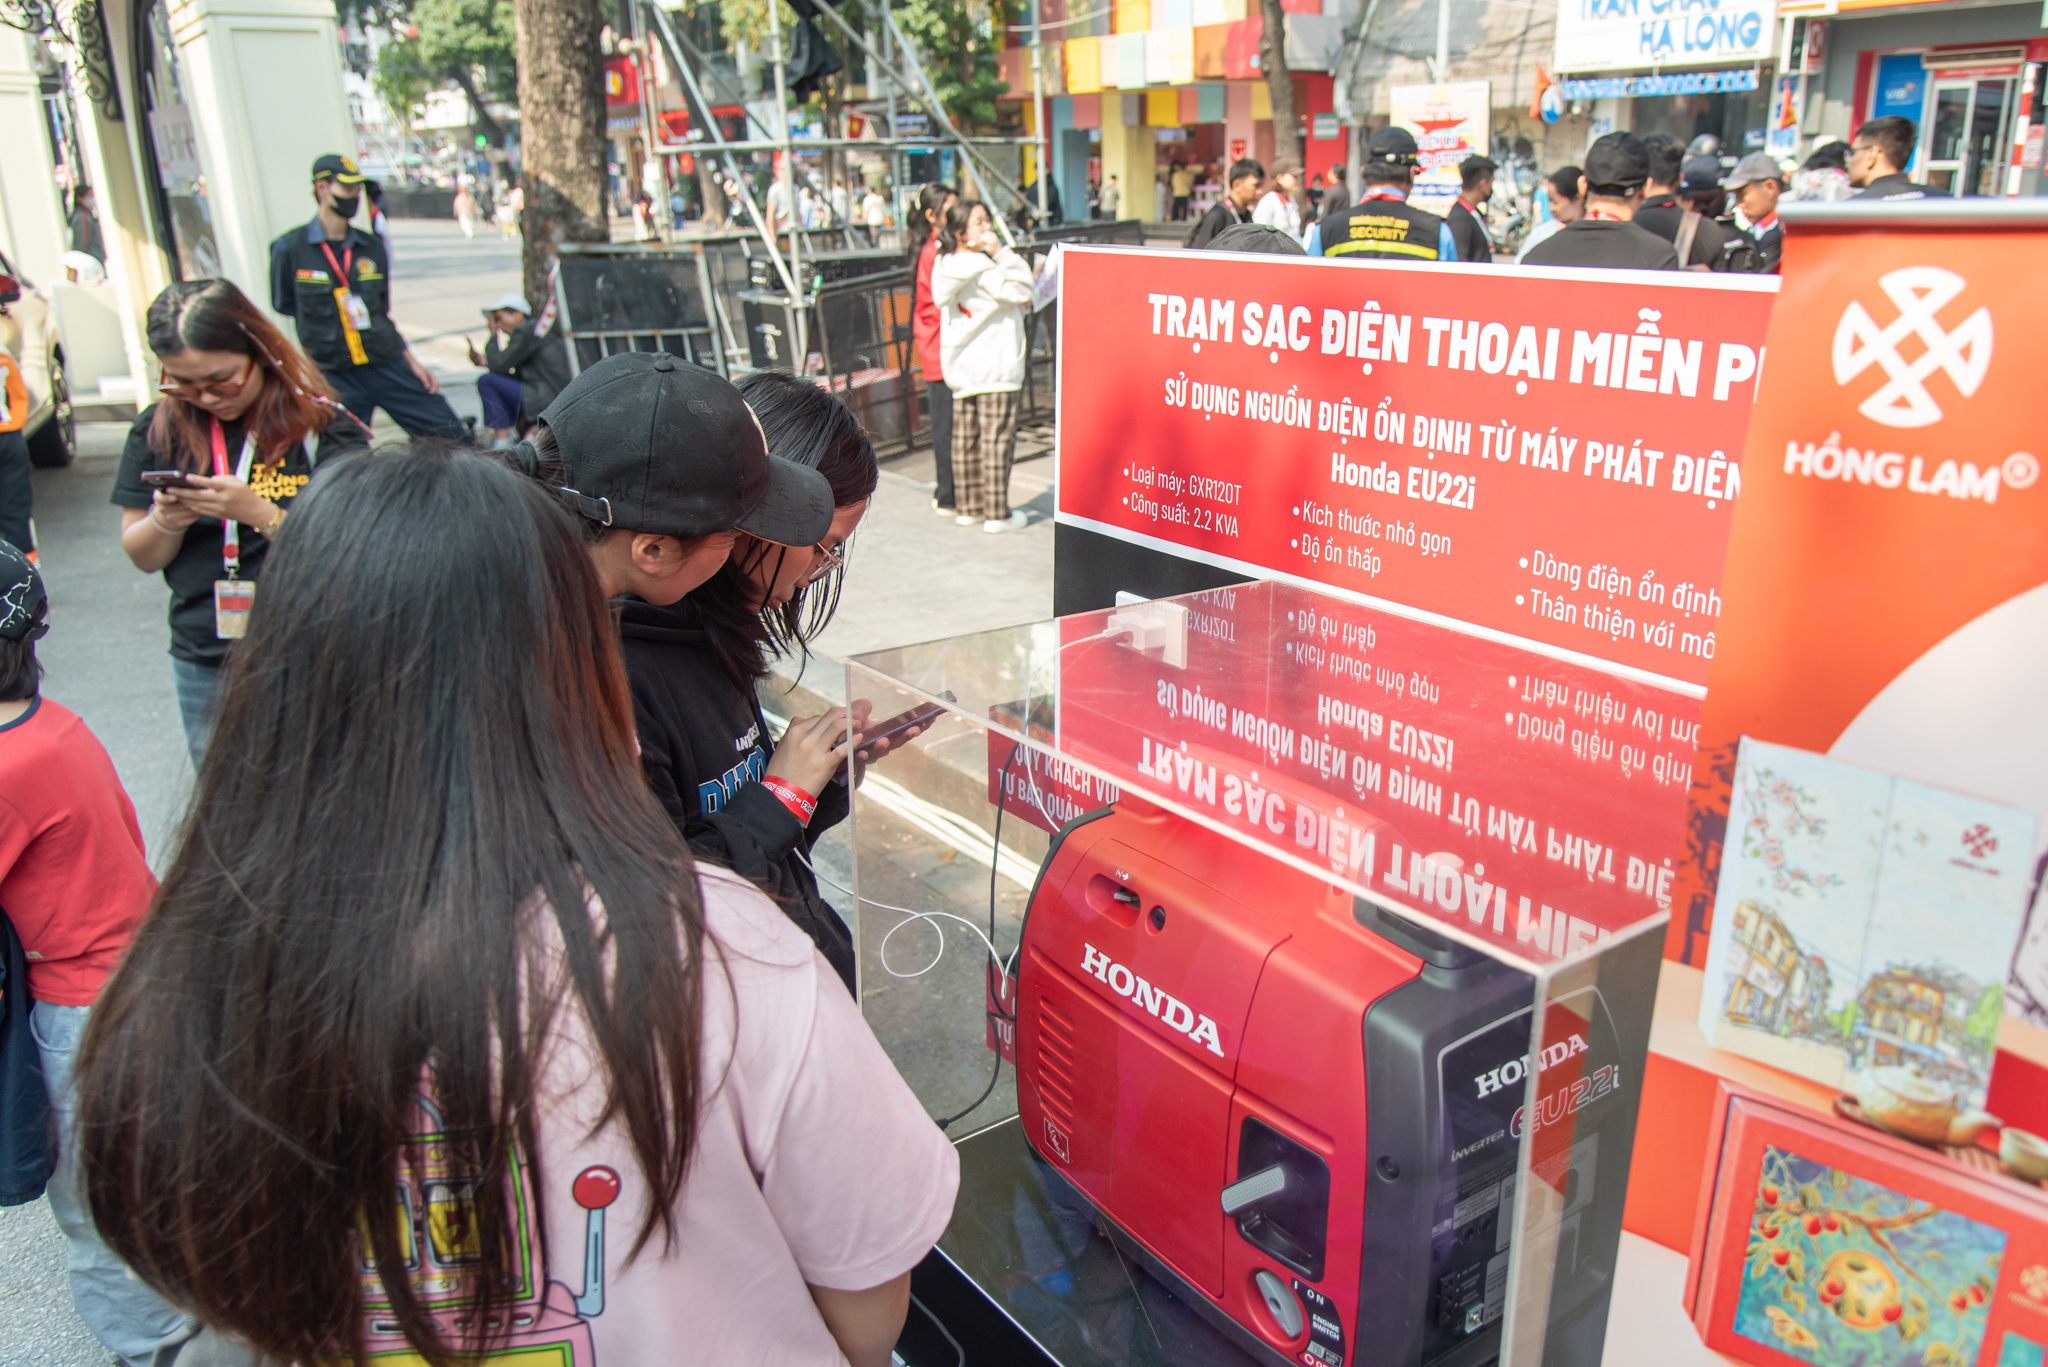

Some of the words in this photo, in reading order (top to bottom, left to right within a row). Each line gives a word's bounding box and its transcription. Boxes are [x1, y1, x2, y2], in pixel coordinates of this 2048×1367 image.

[1684, 11, 1762, 51] LONG
[1350, 226, 1408, 241] SECURITY
[1149, 293, 1235, 354] TRẠM
[1242, 302, 1311, 363] SẠC
[1321, 300, 1412, 376] ĐIỆN
[1423, 317, 1560, 395] THOẠI
[1570, 307, 1703, 398] MIỄN
[1713, 342, 1766, 404] P
[1165, 371, 1188, 408] SỬ
[1191, 382, 1240, 421] DỤNG
[1245, 384, 1312, 429] NGUỒN
[1318, 397, 1368, 445] ĐIỆN
[1374, 396, 1405, 444] ỔN
[1413, 415, 1472, 460] ĐỊNH
[1479, 419, 1517, 462] TỪ
[1520, 427, 1578, 473] MÁY
[1584, 439, 1664, 488] PHÁT
[1672, 450, 1741, 510] ĐIỆN
[1131, 462, 1155, 489] Loại
[1158, 471, 1186, 497] máy:
[1189, 475, 1242, 505] GXR120T
[1331, 452, 1400, 495] Honda
[1407, 466, 1476, 509] EU22i
[1784, 431, 1906, 489] HỒNG
[1907, 455, 2001, 504] LAM
[1131, 492, 1158, 521] Công
[1161, 502, 1190, 525] suất:
[1194, 507, 1212, 531] 2.2
[1215, 512, 1239, 537] KVA
[1303, 500, 1333, 527] Kích
[1338, 509, 1381, 538] thước
[1386, 520, 1416, 546] nhỏ
[1420, 531, 1452, 557] gọn
[1302, 533, 1320, 563] Độ
[1324, 537, 1342, 564] ồn
[1347, 545, 1381, 578] thấp
[1533, 550, 1581, 591] Dòng
[1587, 563, 1632, 599] điện
[1638, 569, 1665, 604] ổn
[1672, 582, 1722, 618] định
[1531, 588, 1577, 624] Thân
[1583, 603, 1635, 641] thiện
[1643, 620, 1675, 649] với
[775, 785, 797, 802] 2024
[1080, 942, 1225, 1058] HONDA
[1474, 1033, 1589, 1099] HONDA
[1307, 1288, 1324, 1305] ON
[1312, 1313, 1340, 1333] ENGINE
[1312, 1320, 1340, 1341] SWITCH
